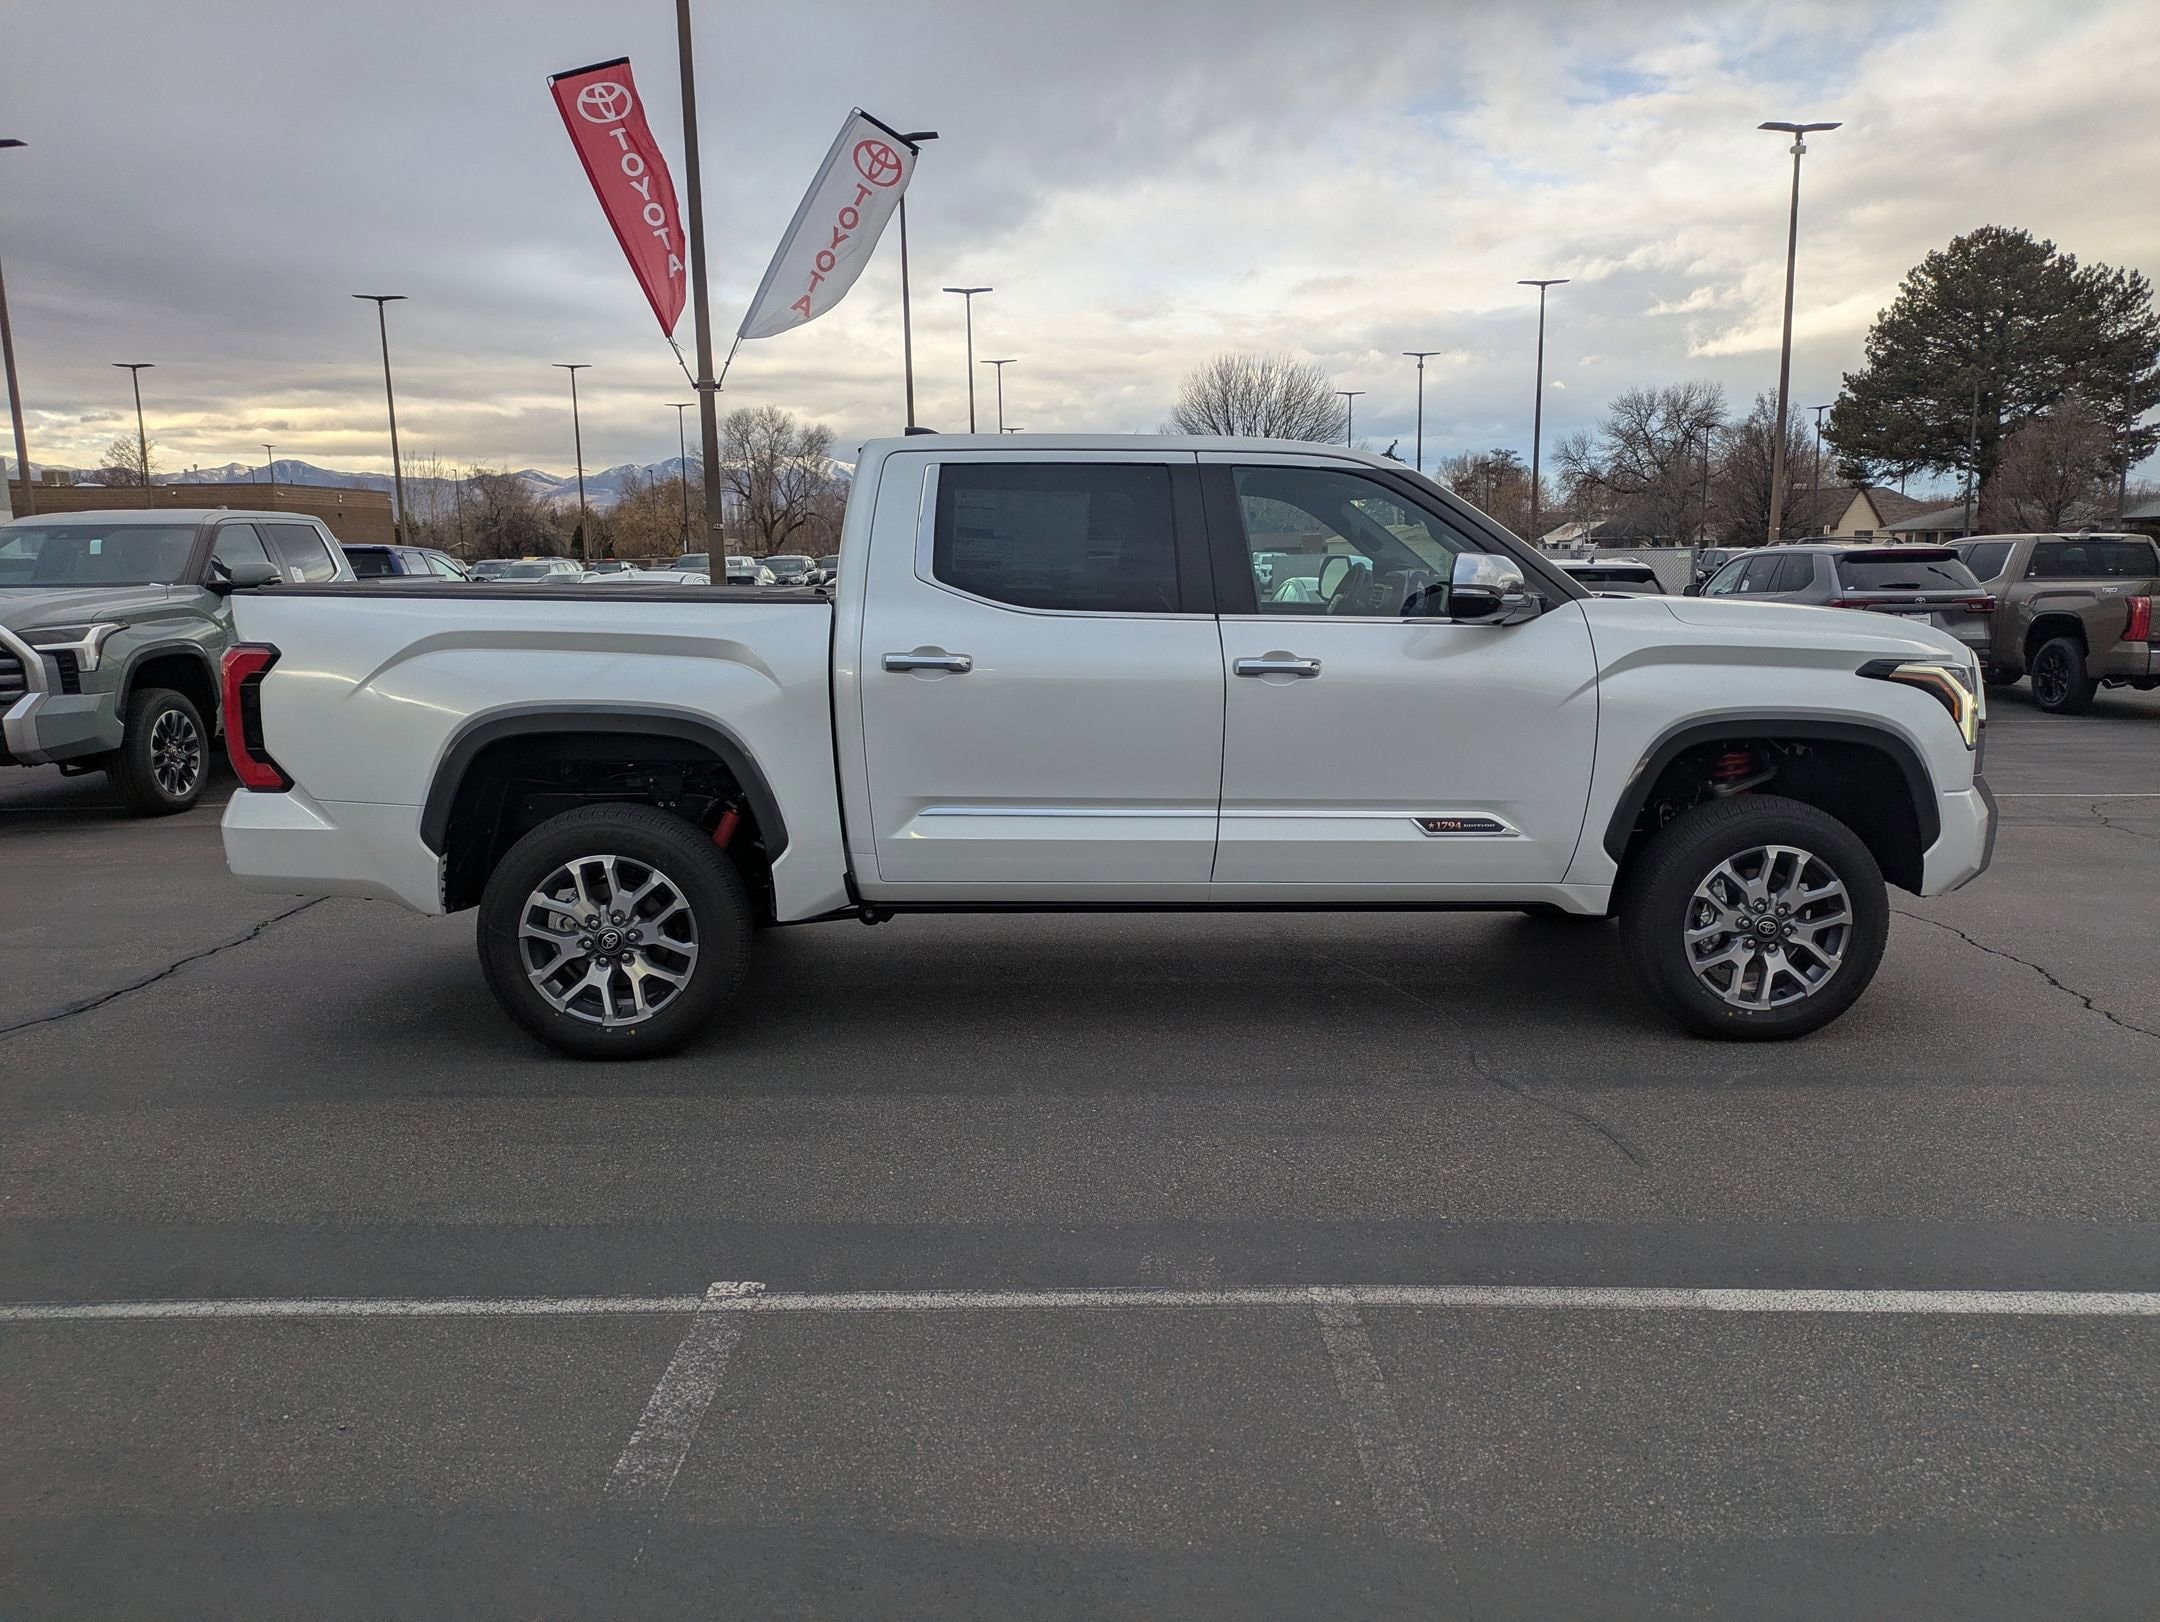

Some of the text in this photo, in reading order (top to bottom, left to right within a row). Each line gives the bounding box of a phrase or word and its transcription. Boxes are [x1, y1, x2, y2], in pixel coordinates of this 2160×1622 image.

[609, 127, 684, 278] TOYOTA
[790, 183, 873, 318] TOYOTA
[1436, 821, 1461, 830] 1794
